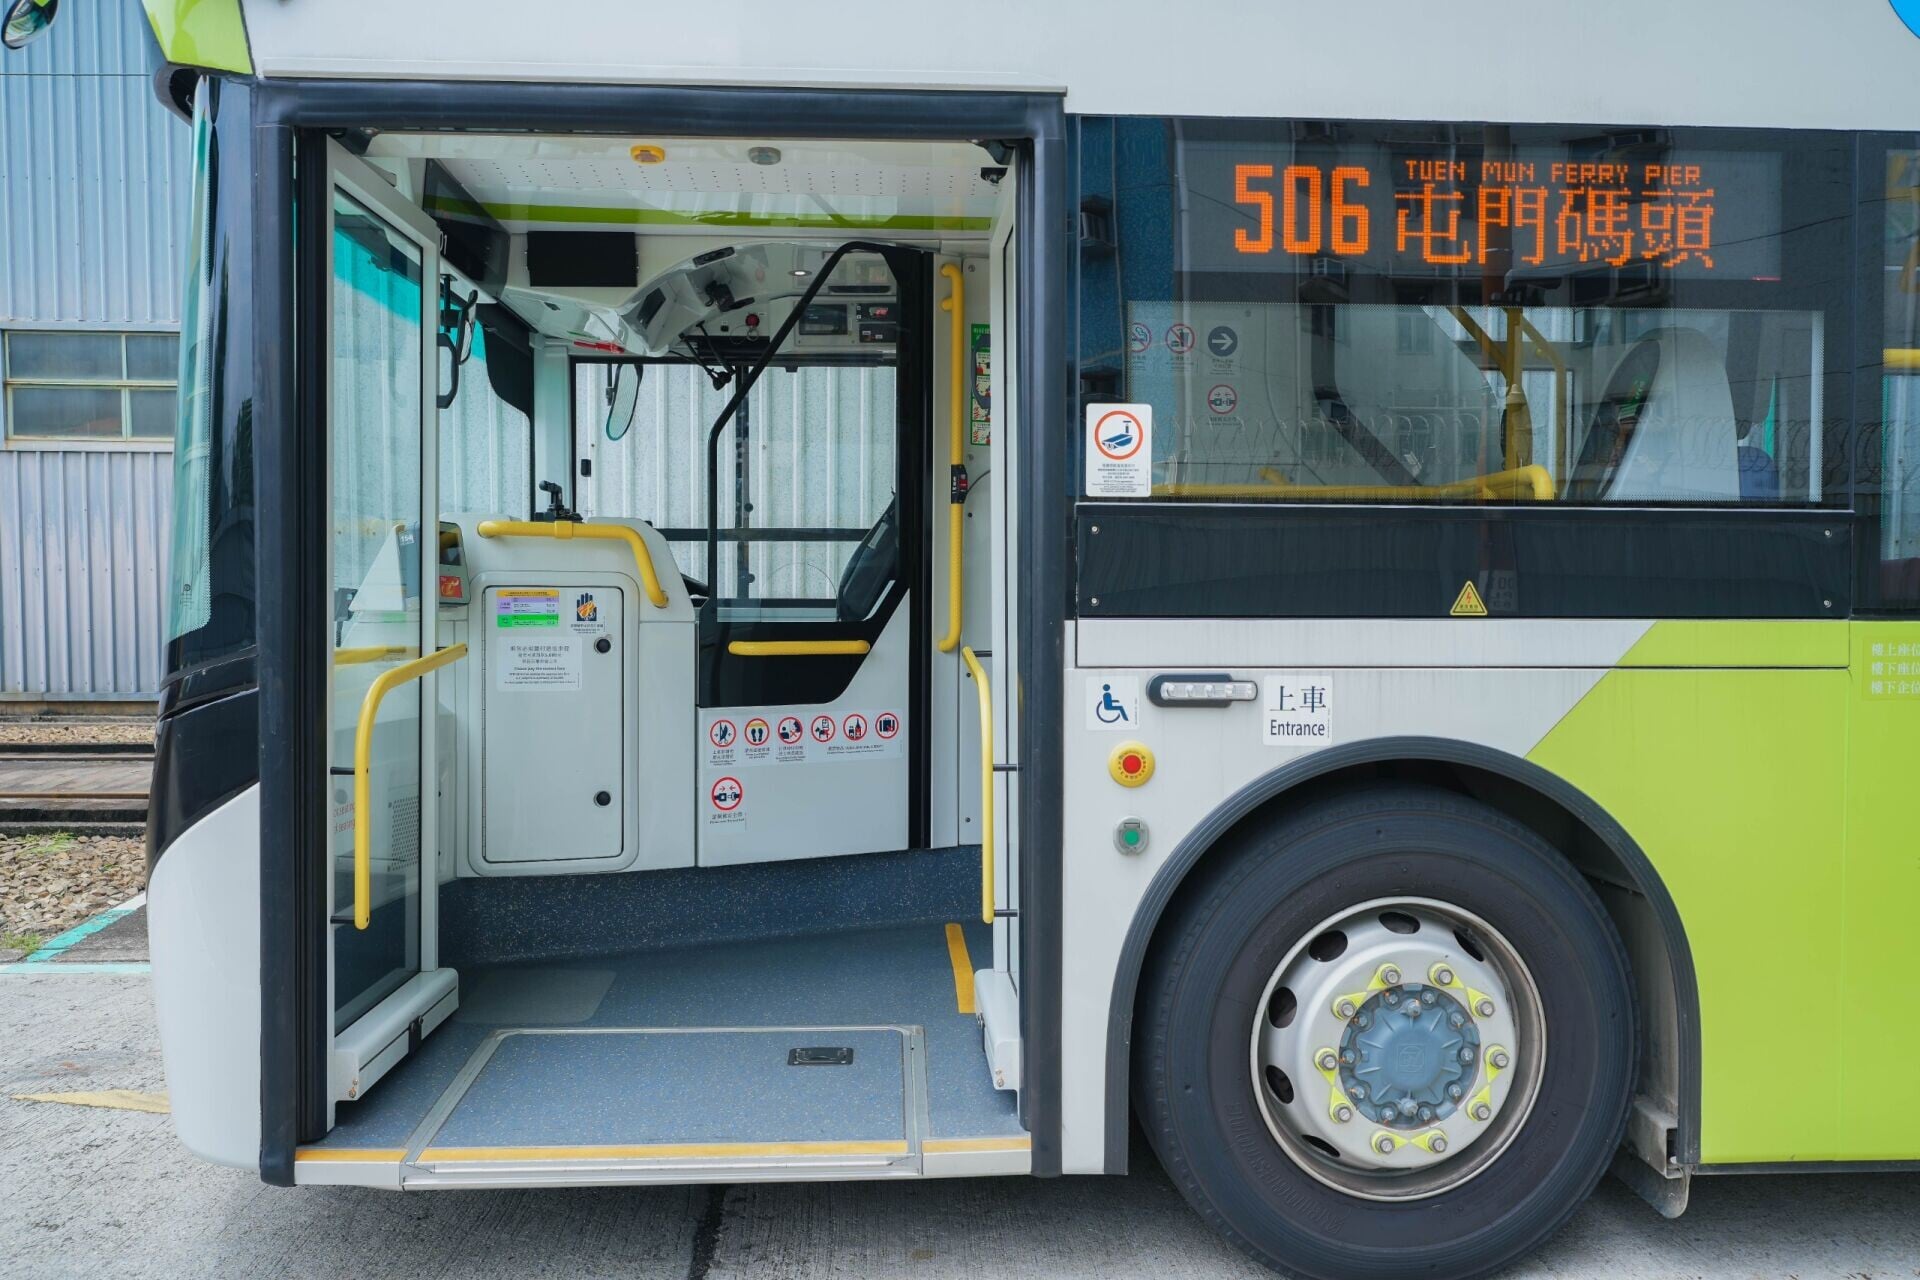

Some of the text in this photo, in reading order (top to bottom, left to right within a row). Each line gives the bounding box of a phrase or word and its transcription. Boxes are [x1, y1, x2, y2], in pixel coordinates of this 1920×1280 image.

[1405, 160, 1701, 185] TUEN MUN FERRY PIER
[1235, 164, 1370, 255] 506
[1395, 183, 1714, 268] 屯門碼頭
[1269, 684, 1327, 713] 上車
[1270, 719, 1326, 736] Entrance
